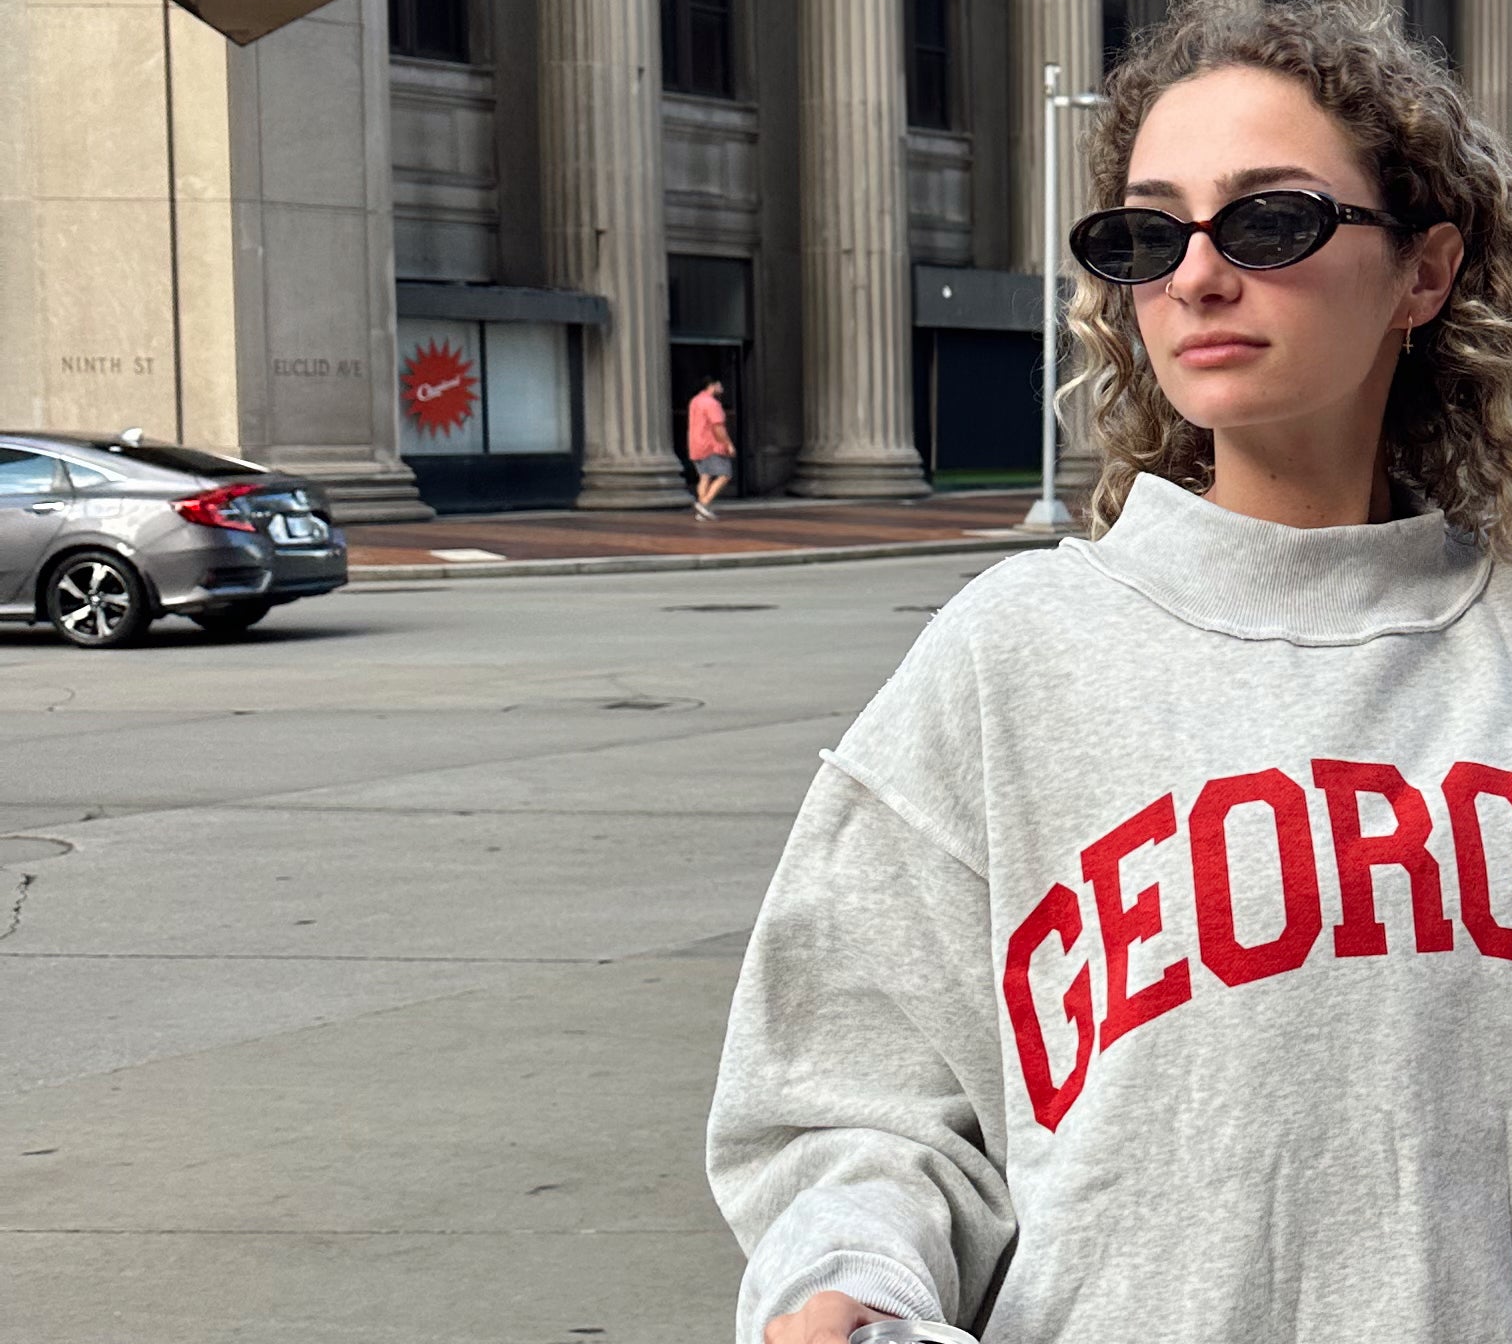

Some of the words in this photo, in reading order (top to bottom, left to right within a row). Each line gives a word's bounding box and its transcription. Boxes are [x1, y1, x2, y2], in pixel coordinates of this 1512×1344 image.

[61, 356, 122, 375] NINTH
[134, 357, 155, 376] ST
[273, 357, 330, 377] EUCLID
